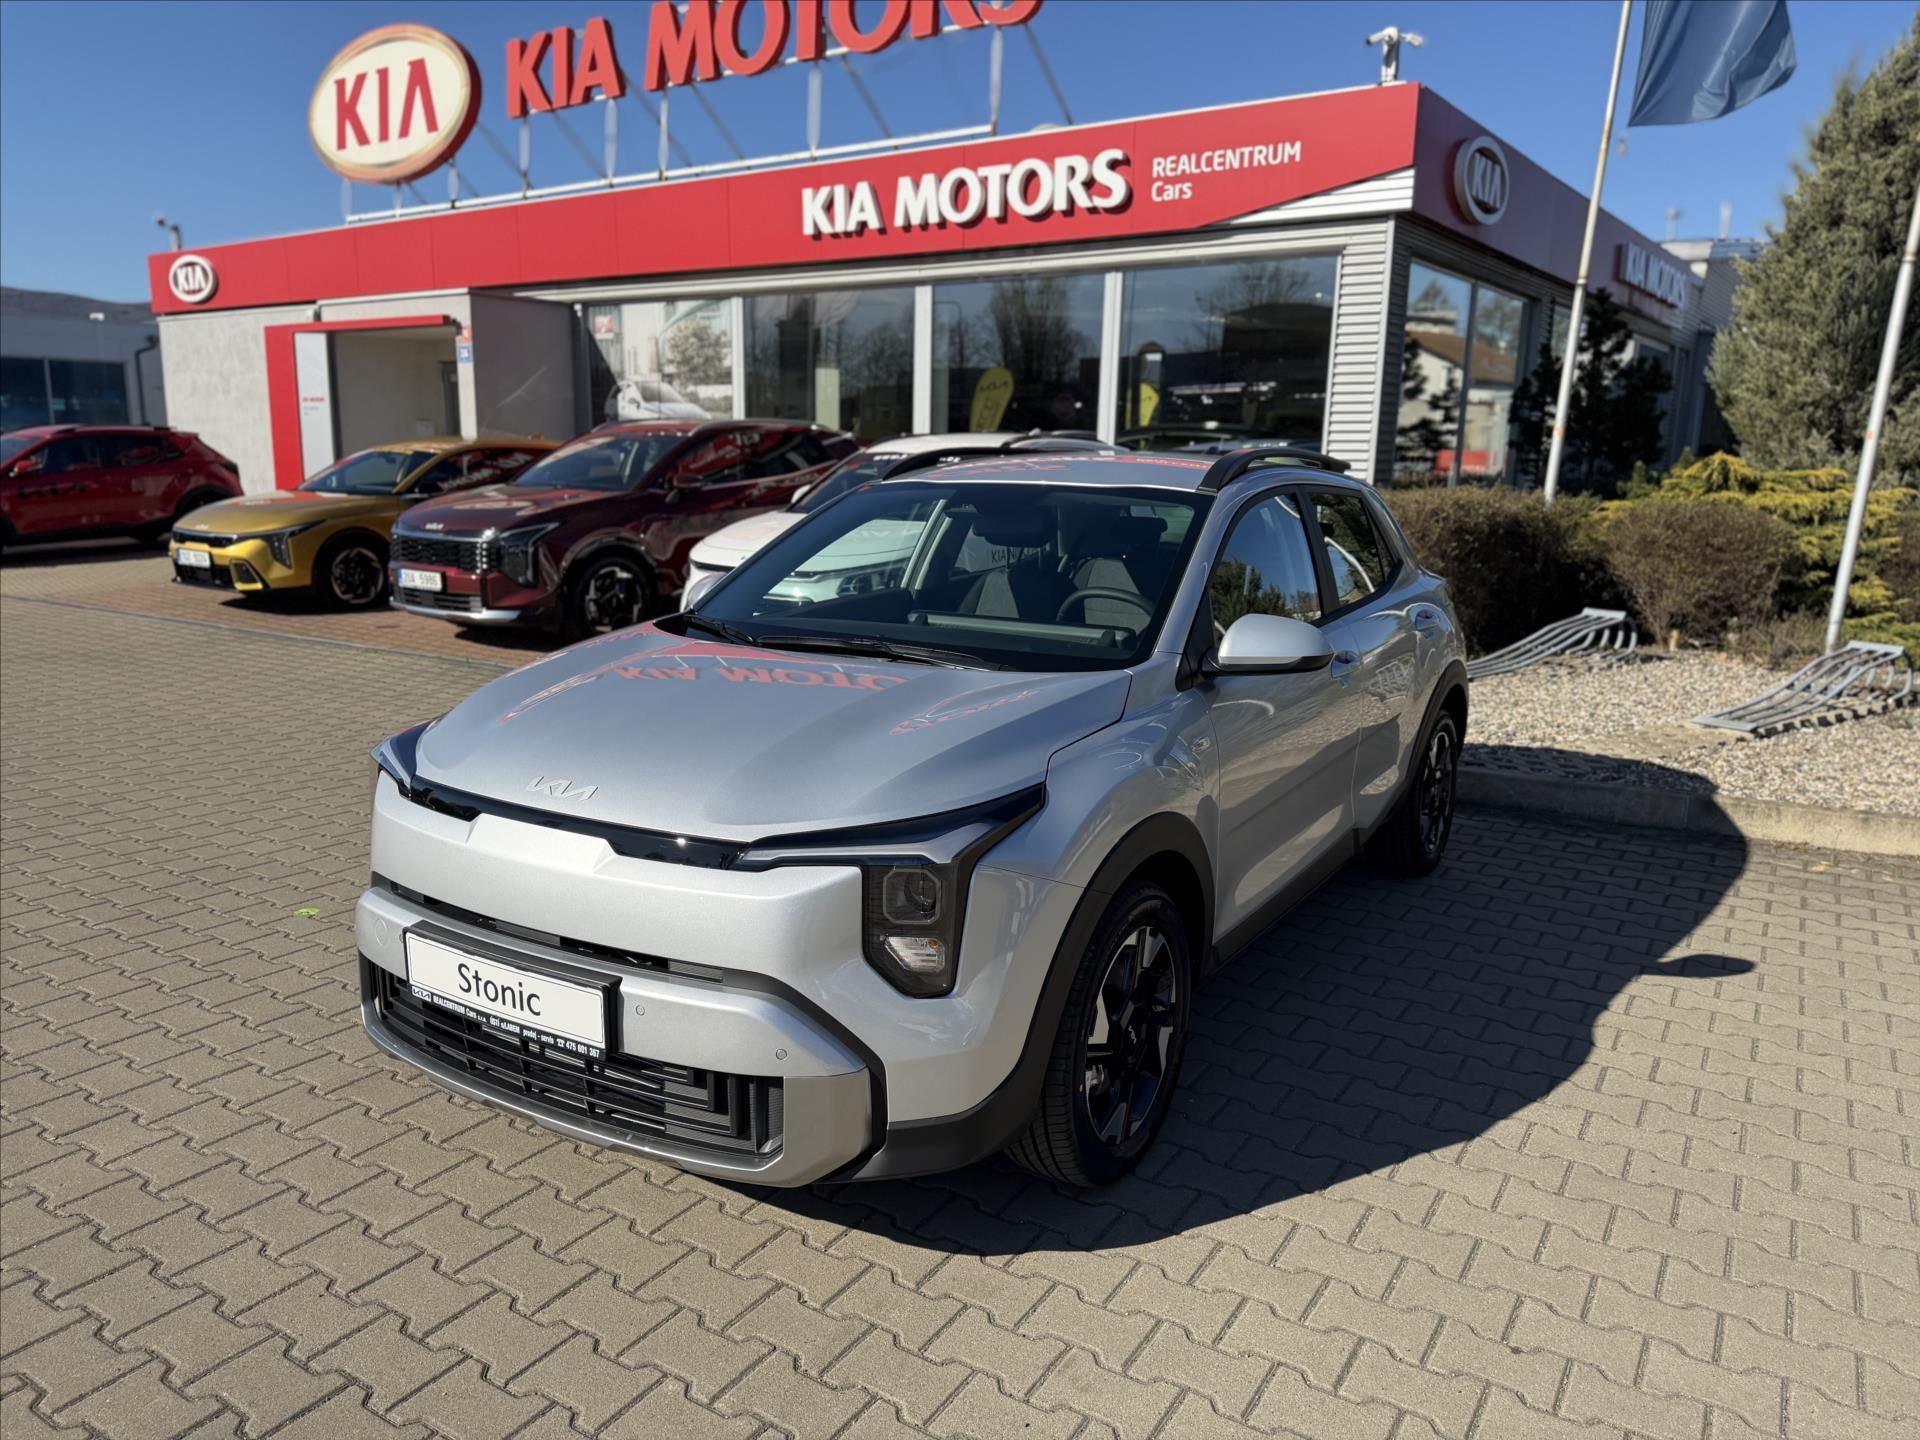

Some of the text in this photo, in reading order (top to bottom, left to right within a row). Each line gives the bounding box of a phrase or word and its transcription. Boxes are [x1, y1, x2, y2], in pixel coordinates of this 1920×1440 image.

[506, 16, 626, 118] KIA
[334, 58, 439, 151] KIA
[1153, 141, 1302, 177] REALCENTRUM
[1471, 151, 1501, 209] KIA
[802, 148, 1129, 236] KIA MOTORS
[1151, 180, 1192, 202] Cars
[176, 265, 206, 292] KIA
[457, 963, 541, 1016] Stonic
[433, 994, 466, 1015] REALCENTRUM
[566, 1041, 576, 1051] 475
